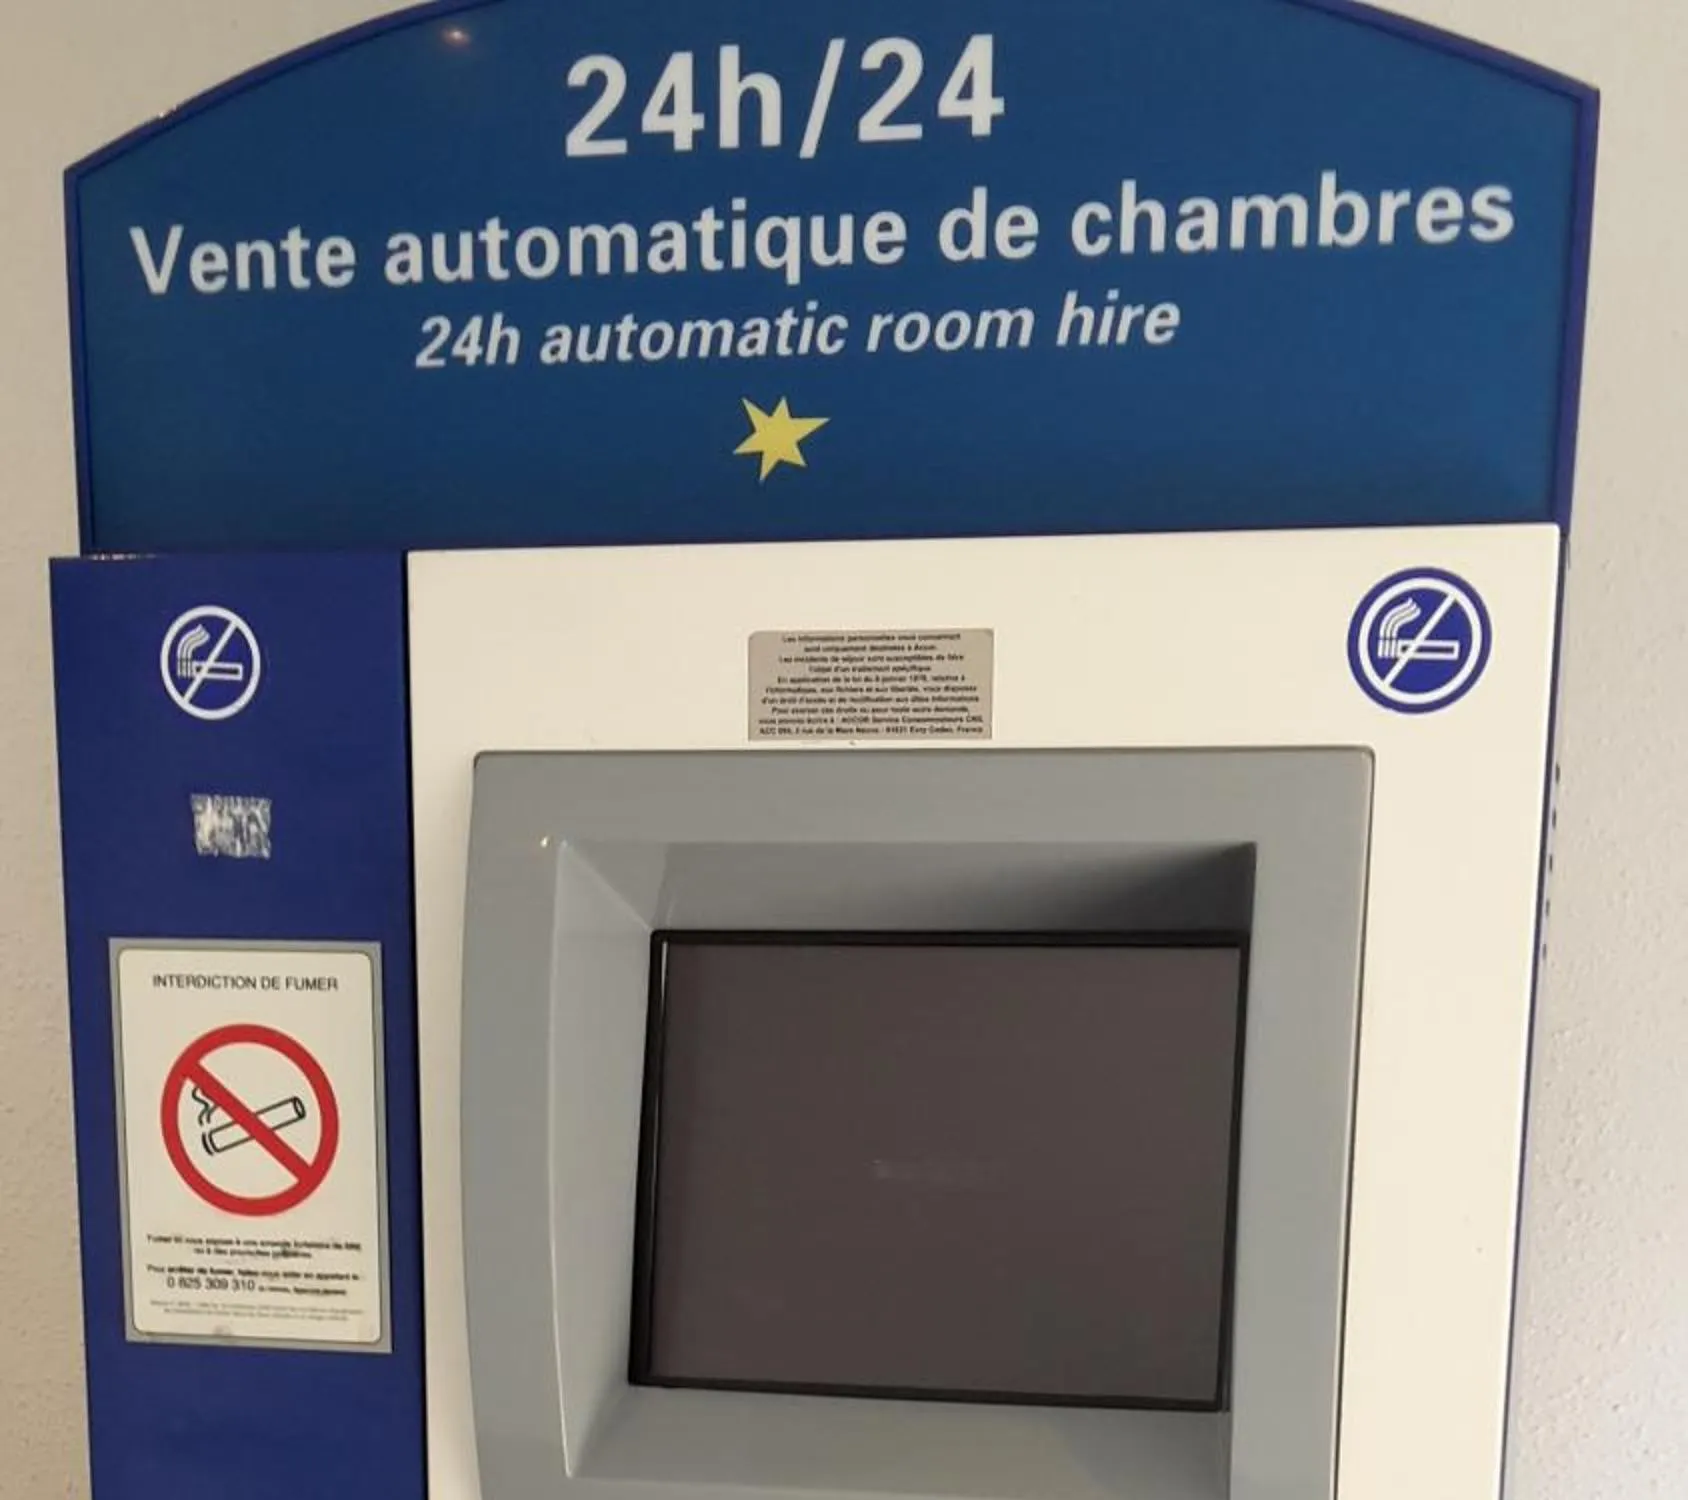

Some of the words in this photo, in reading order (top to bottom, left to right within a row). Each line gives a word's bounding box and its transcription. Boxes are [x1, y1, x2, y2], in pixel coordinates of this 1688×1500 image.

[566, 34, 1005, 158] 24h/24
[130, 225, 356, 295] Vente
[385, 197, 907, 286] automatique
[938, 186, 1039, 263] de
[1071, 171, 1515, 257] chambres
[415, 313, 520, 367] 24h
[540, 301, 849, 364] automatic
[867, 308, 1035, 352] room
[1056, 291, 1180, 346] hire
[153, 972, 257, 990] INTERDICTION
[260, 975, 281, 990] DE
[285, 976, 339, 992] FUMER
